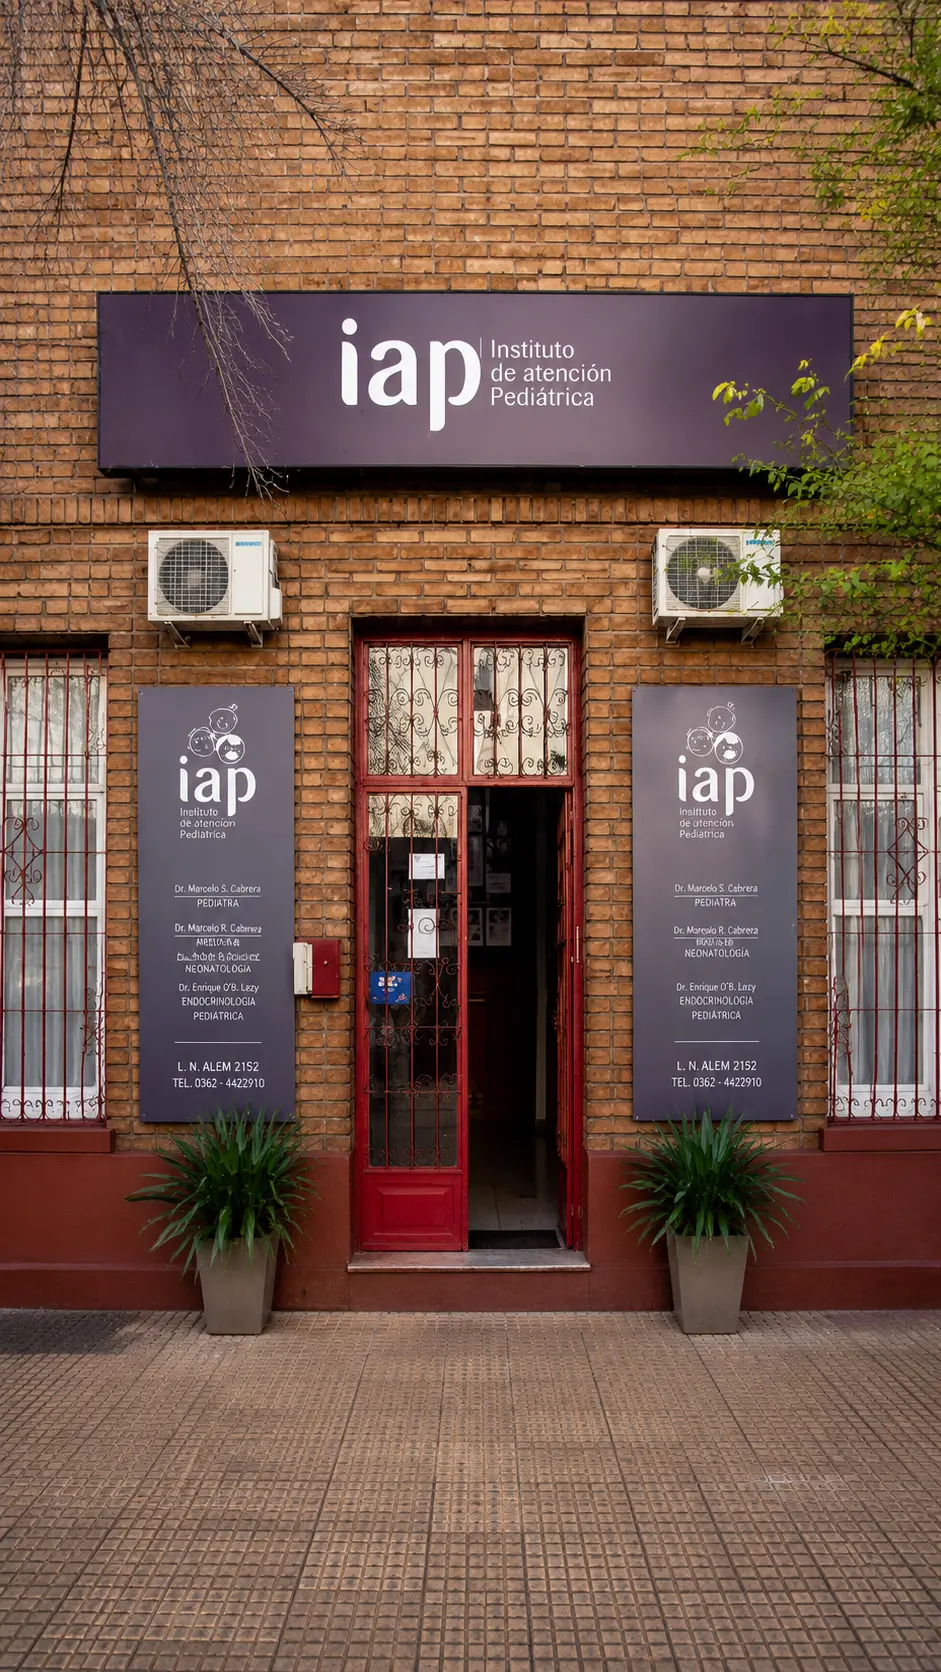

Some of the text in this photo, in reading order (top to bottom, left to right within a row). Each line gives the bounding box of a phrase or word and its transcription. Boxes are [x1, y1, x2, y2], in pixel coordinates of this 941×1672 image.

[490, 339, 575, 359] Instituto
[341, 317, 481, 432] iap
[490, 363, 612, 382] de atención
[490, 387, 595, 406] Pediátrica
[179, 755, 257, 817] iap
[678, 754, 755, 817] iap
[679, 819, 691, 828] de
[174, 884, 187, 893] Dr.
[221, 884, 229, 893] S.
[230, 884, 262, 893] Cabrera
[674, 884, 687, 893] Dr.
[197, 898, 240, 908] PEDIATRA
[695, 898, 737, 907] PEDIATRA
[174, 923, 187, 933] Dr.
[673, 926, 686, 935] Dr.
[178, 983, 191, 992] Dr.
[676, 982, 688, 992] Dr.
[177, 1062, 187, 1072] L.
[189, 1062, 201, 1072] N.
[203, 1061, 232, 1072] ALEM
[676, 1061, 757, 1071] L. N. ALEM 2152
[172, 1078, 193, 1089] TEL.
[195, 1078, 218, 1089] 0362
[225, 1078, 265, 1089] 4422910
[671, 1077, 691, 1088] TEL.
[693, 1077, 716, 1088] 0362
[723, 1077, 763, 1088] 4422910
